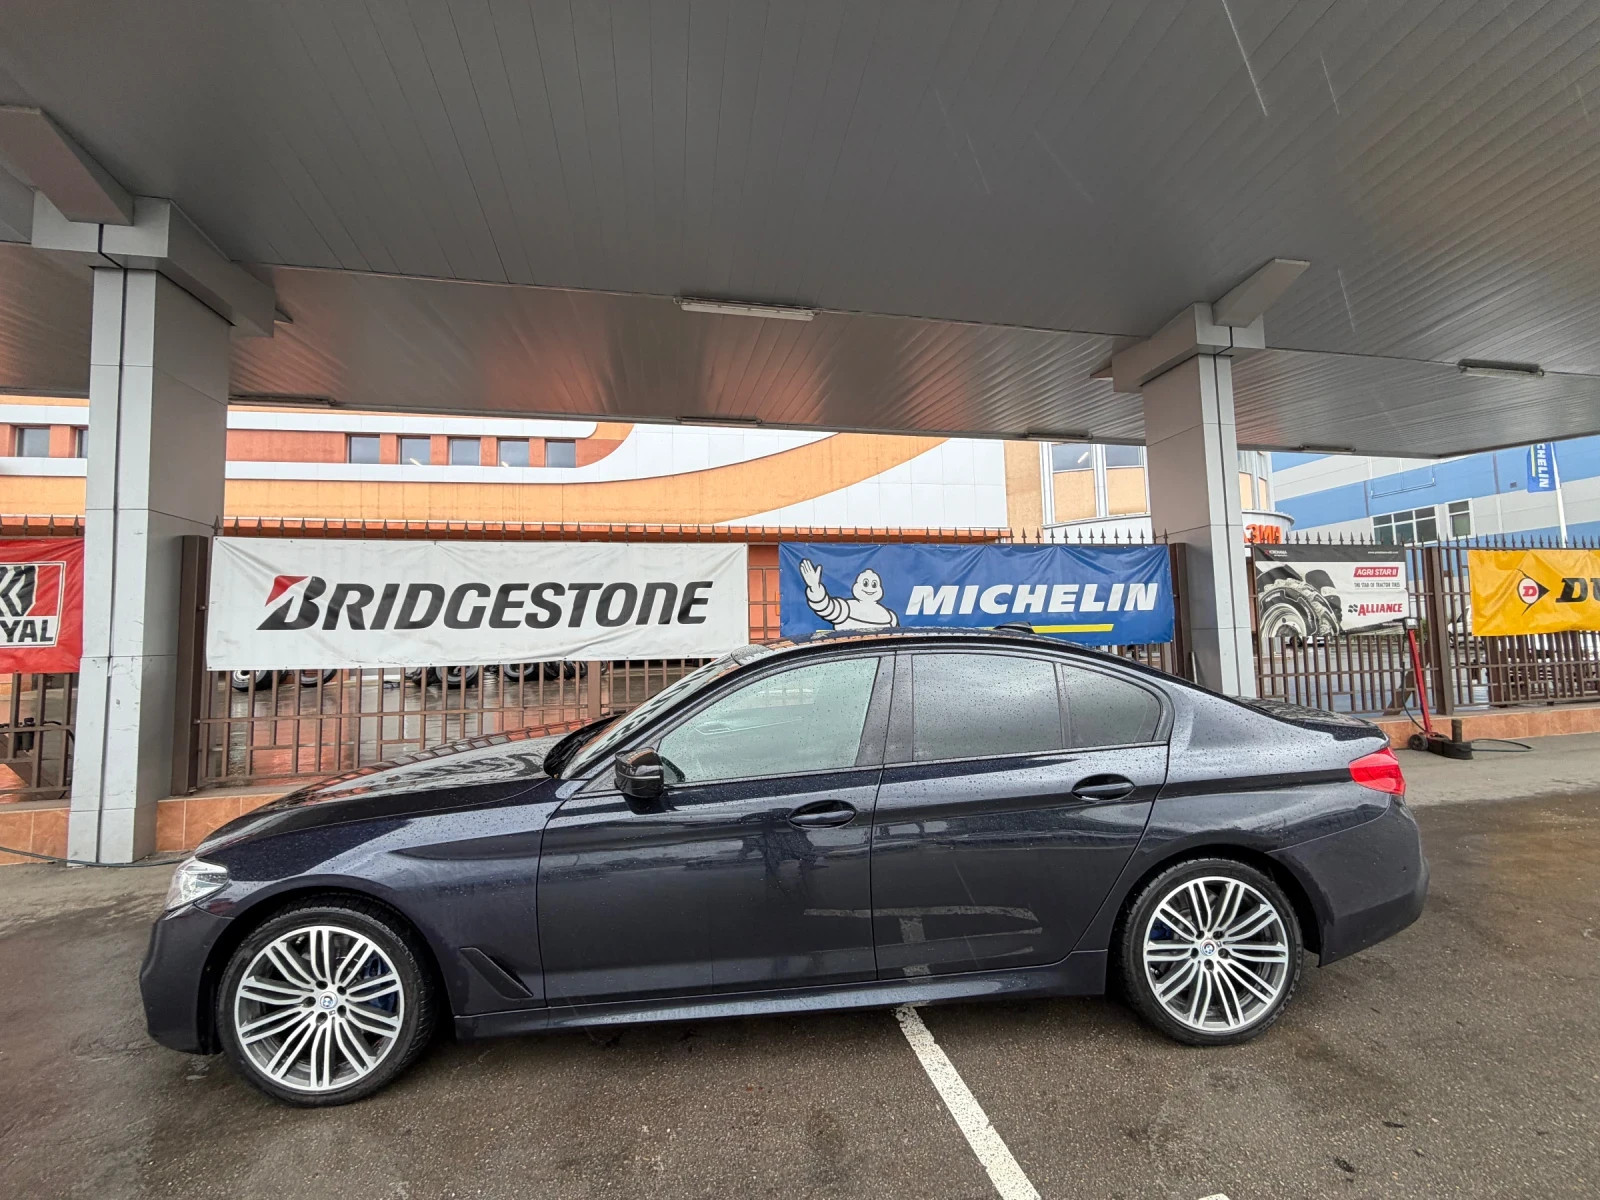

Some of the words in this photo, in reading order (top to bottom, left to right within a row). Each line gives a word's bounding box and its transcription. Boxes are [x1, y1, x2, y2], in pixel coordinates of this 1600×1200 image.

[1356, 568, 1374, 576] AGRI
[1374, 568, 1392, 576] STAR
[256, 575, 713, 631] BRIDGESTONE
[904, 583, 1159, 616] MICHELIN
[1358, 603, 1403, 616] ALLIANCE
